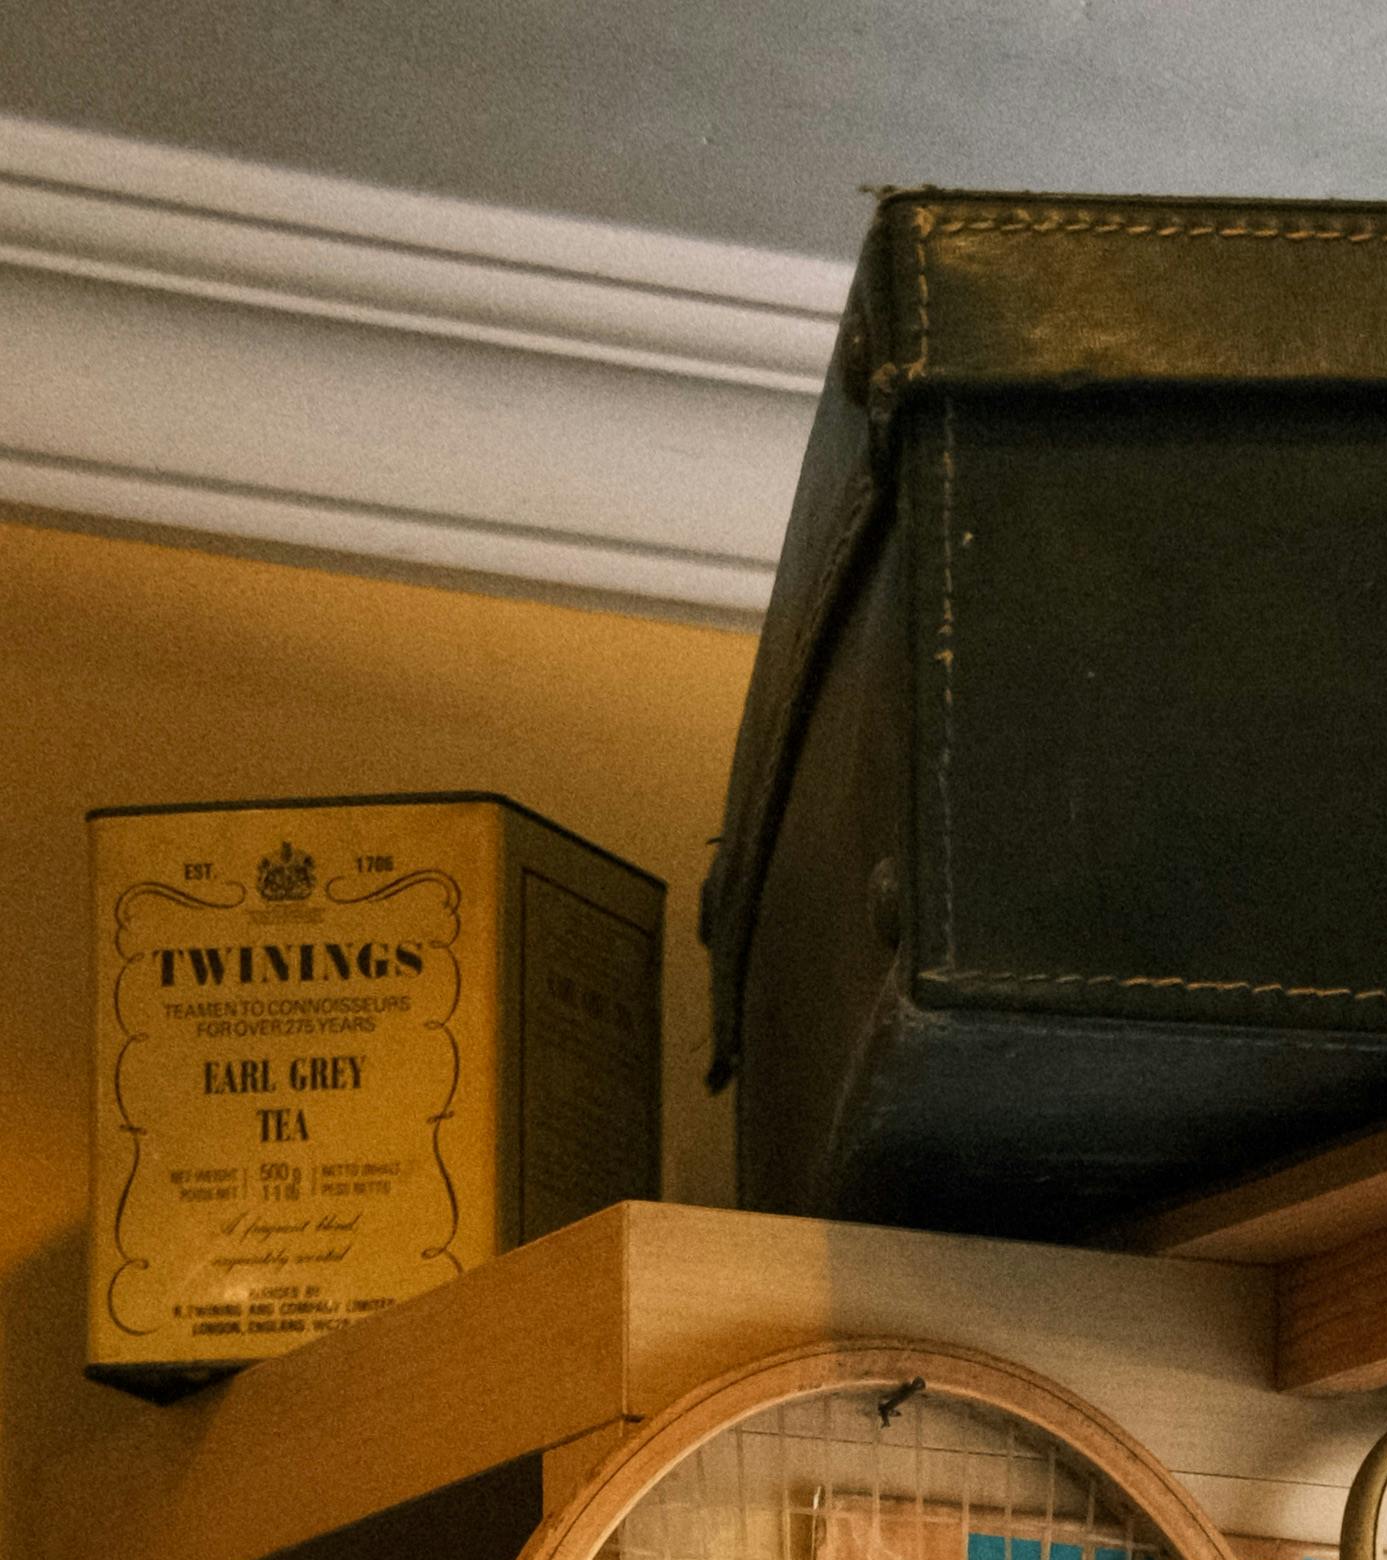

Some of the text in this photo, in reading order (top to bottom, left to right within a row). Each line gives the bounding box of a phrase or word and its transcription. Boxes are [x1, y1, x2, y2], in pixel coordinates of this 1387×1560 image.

[183, 855, 394, 881] EST. 1706
[153, 942, 423, 987] TWININGS
[164, 996, 412, 1020] TEAMEN TO CONNOISSEURS
[198, 1021, 236, 1038] FOR
[238, 1019, 285, 1037] OVER
[321, 1015, 377, 1034] YEARS
[203, 1054, 366, 1095] EARL GREY
[256, 1108, 310, 1143] TEA
